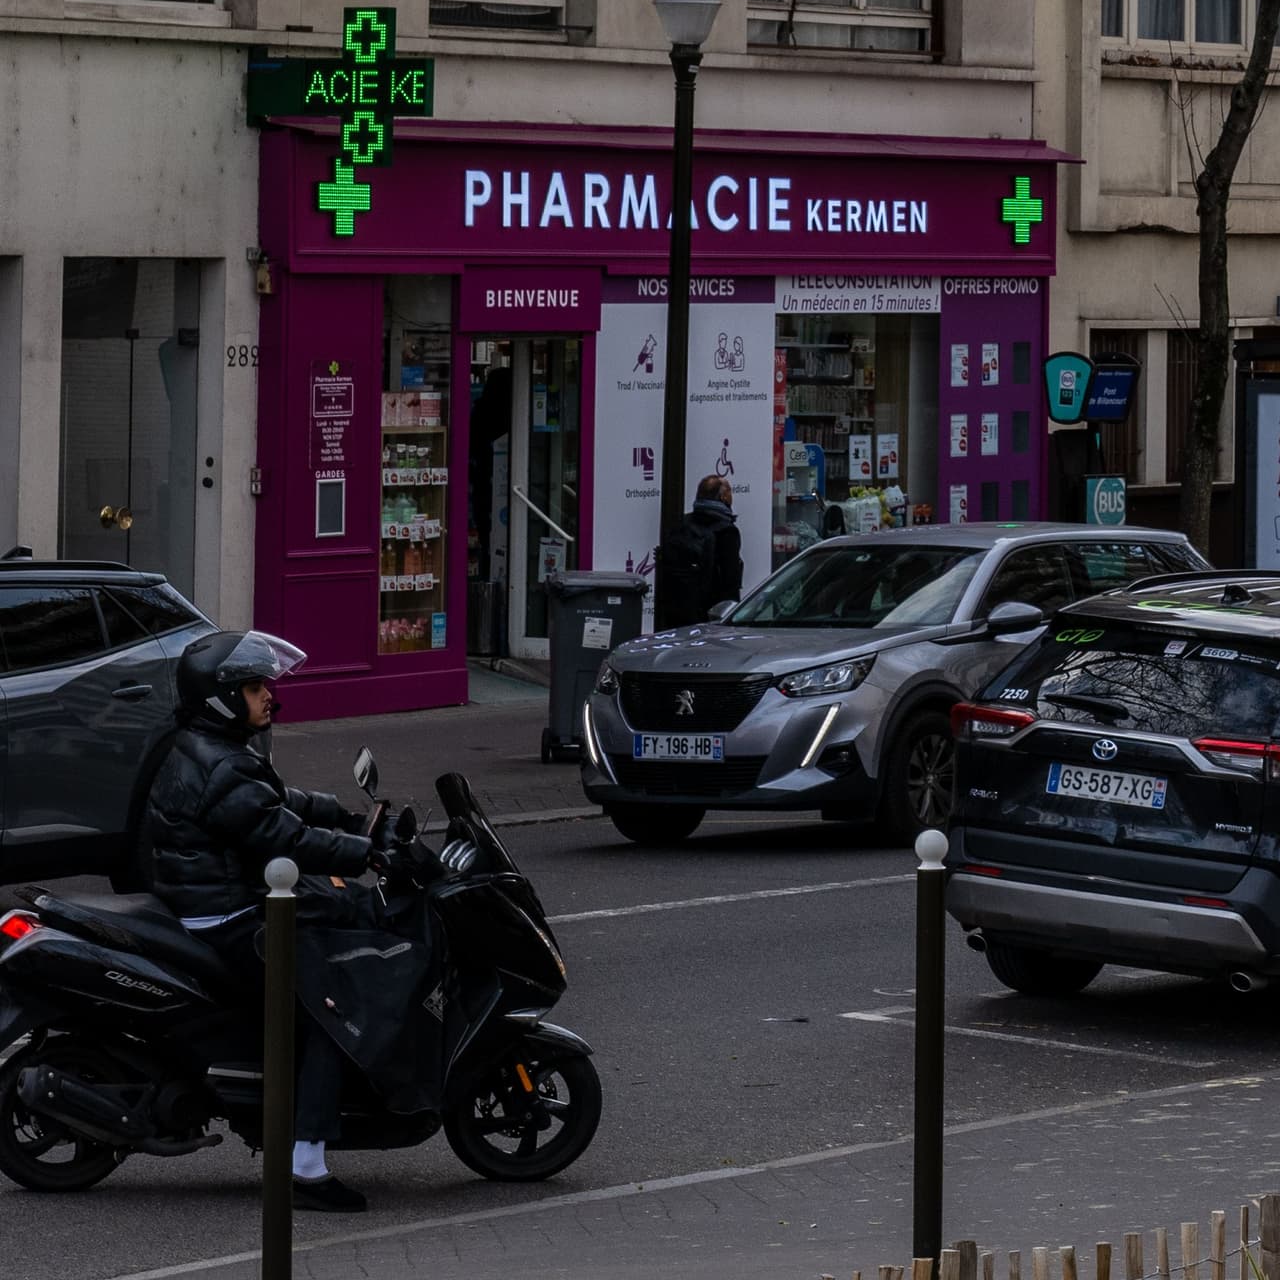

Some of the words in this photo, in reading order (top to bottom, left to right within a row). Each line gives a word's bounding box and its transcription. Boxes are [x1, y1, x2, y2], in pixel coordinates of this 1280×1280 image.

[306, 71, 378, 103] ACIE
[391, 71, 424, 103] KE
[807, 199, 926, 233] KERMEN
[638, 278, 668, 296] NOS
[689, 278, 735, 296] RVICES
[944, 279, 990, 295] OFFRES
[993, 279, 1039, 295] PROMO
[486, 289, 579, 308] BIENVENUE
[782, 295, 798, 310] Un
[801, 294, 850, 310] médecin
[853, 299, 866, 310] en
[870, 295, 883, 310] 15
[886, 294, 932, 310] minutes
[934, 295, 939, 310] !
[227, 345, 259, 367] 282
[637, 381, 665, 391] Vaccinati
[708, 380, 728, 390] Angine
[730, 380, 750, 390] Cystite
[690, 393, 724, 402] diagnostics
[725, 394, 731, 402] et
[732, 393, 767, 402] traitements
[315, 470, 345, 479] GARDES
[625, 488, 660, 498] Orthopédie
[1099, 491, 1125, 513] BUS
[1204, 648, 1234, 658] 3607
[1000, 689, 1029, 700] 7250
[643, 736, 711, 755] FY-196-HB
[1061, 769, 1152, 801] GS-587-XG
